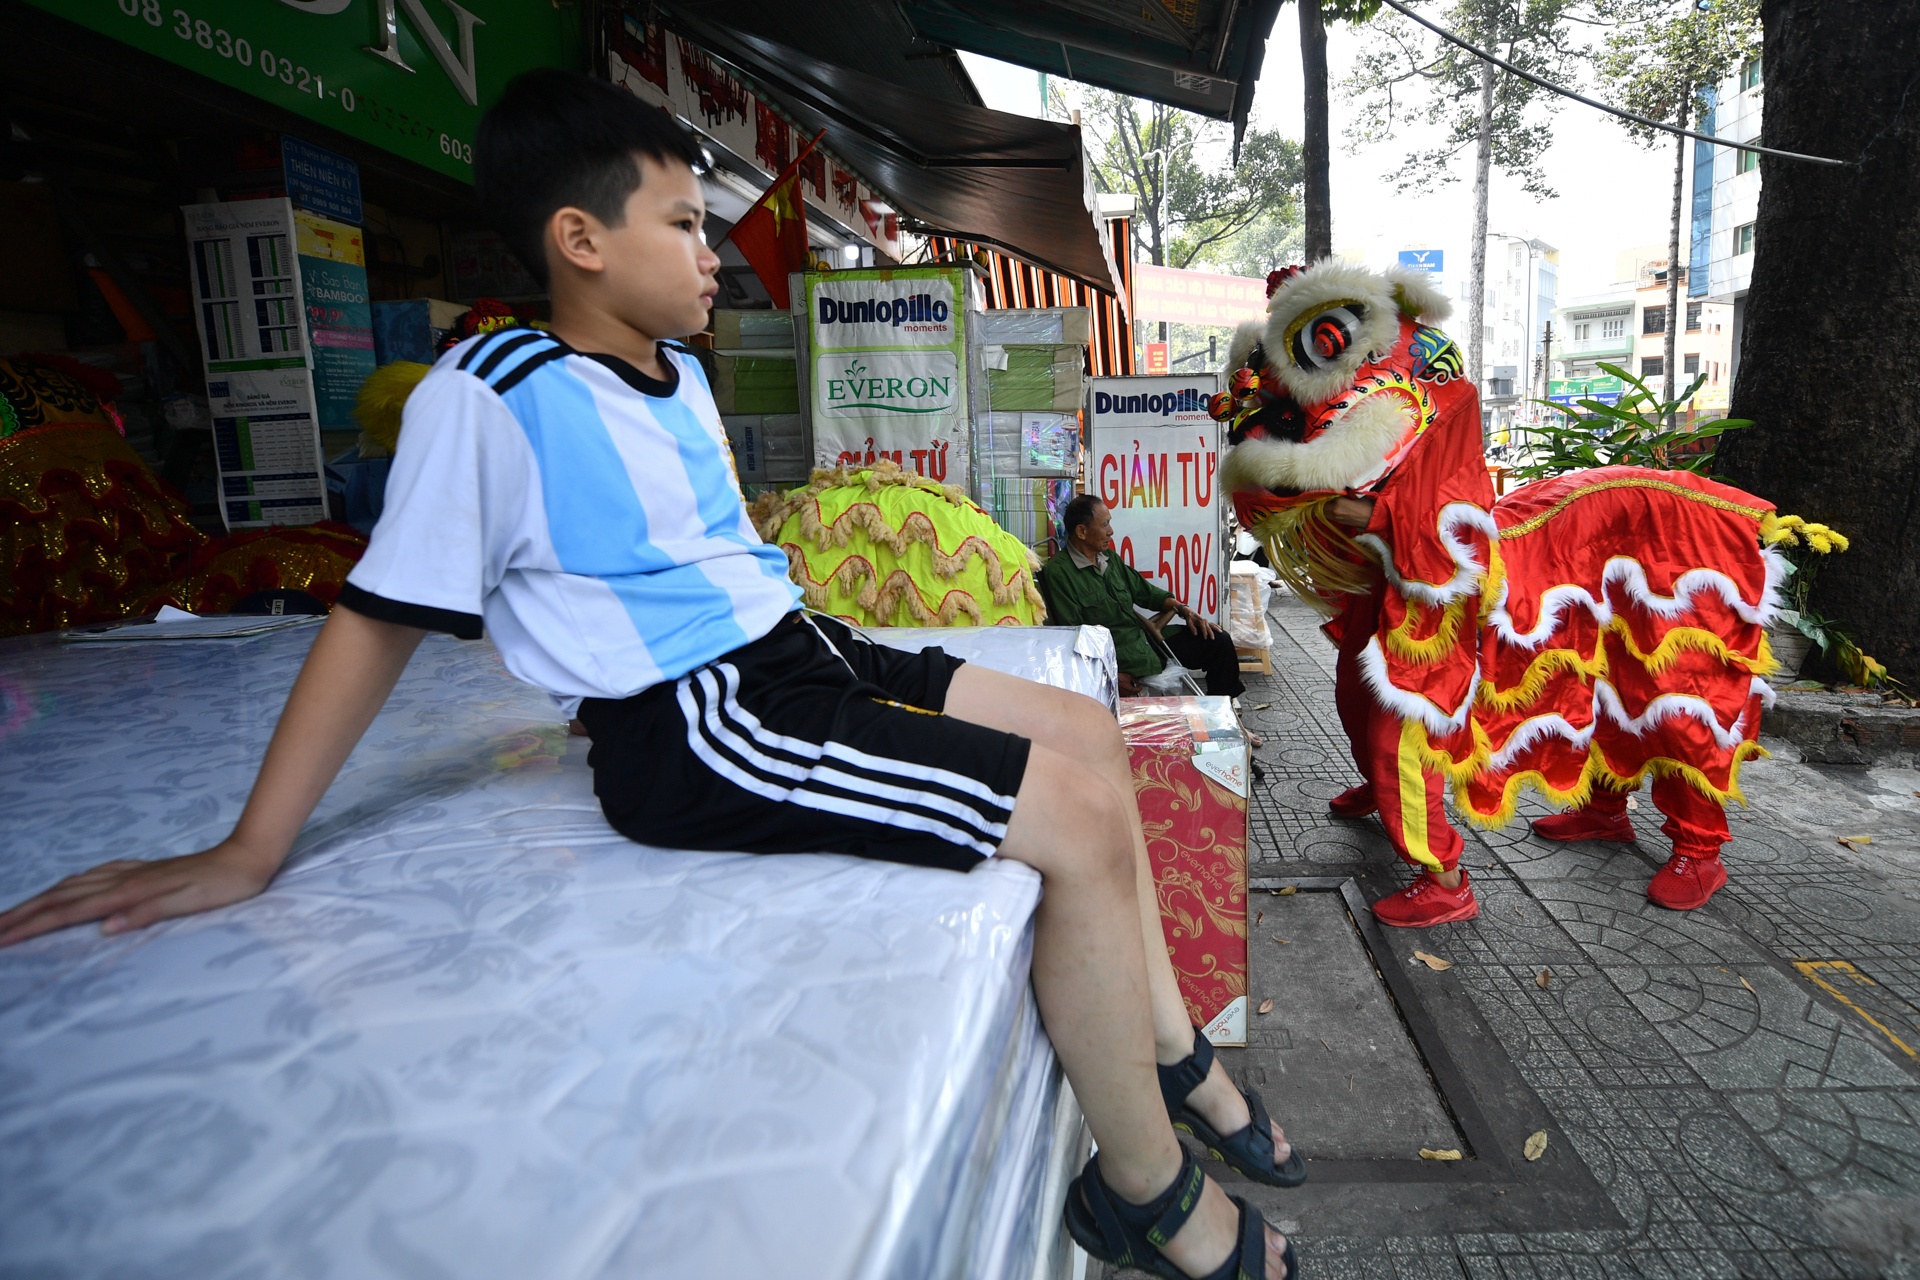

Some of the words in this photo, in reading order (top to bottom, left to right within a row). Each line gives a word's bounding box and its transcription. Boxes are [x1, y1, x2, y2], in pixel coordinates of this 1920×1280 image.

[172, 9, 253, 67] 3830
[440, 133, 472, 165] 603
[290, 158, 317, 179] THIÊN
[318, 168, 340, 187] NIÊN
[316, 288, 364, 304] BAMBOO
[819, 294, 948, 327] Dunlopillo
[904, 324, 947, 332] moments
[827, 376, 951, 400] EVERON
[1095, 388, 1211, 416] Dunlopillo
[910, 439, 949, 483] TỪ
[1100, 439, 1168, 510] GIẢM
[1177, 436, 1216, 507] TỪ
[1206, 761, 1242, 787] everhome
[1181, 850, 1222, 890] everhome
[1182, 976, 1221, 1014] everhome
[1208, 1006, 1240, 1036] everhome
